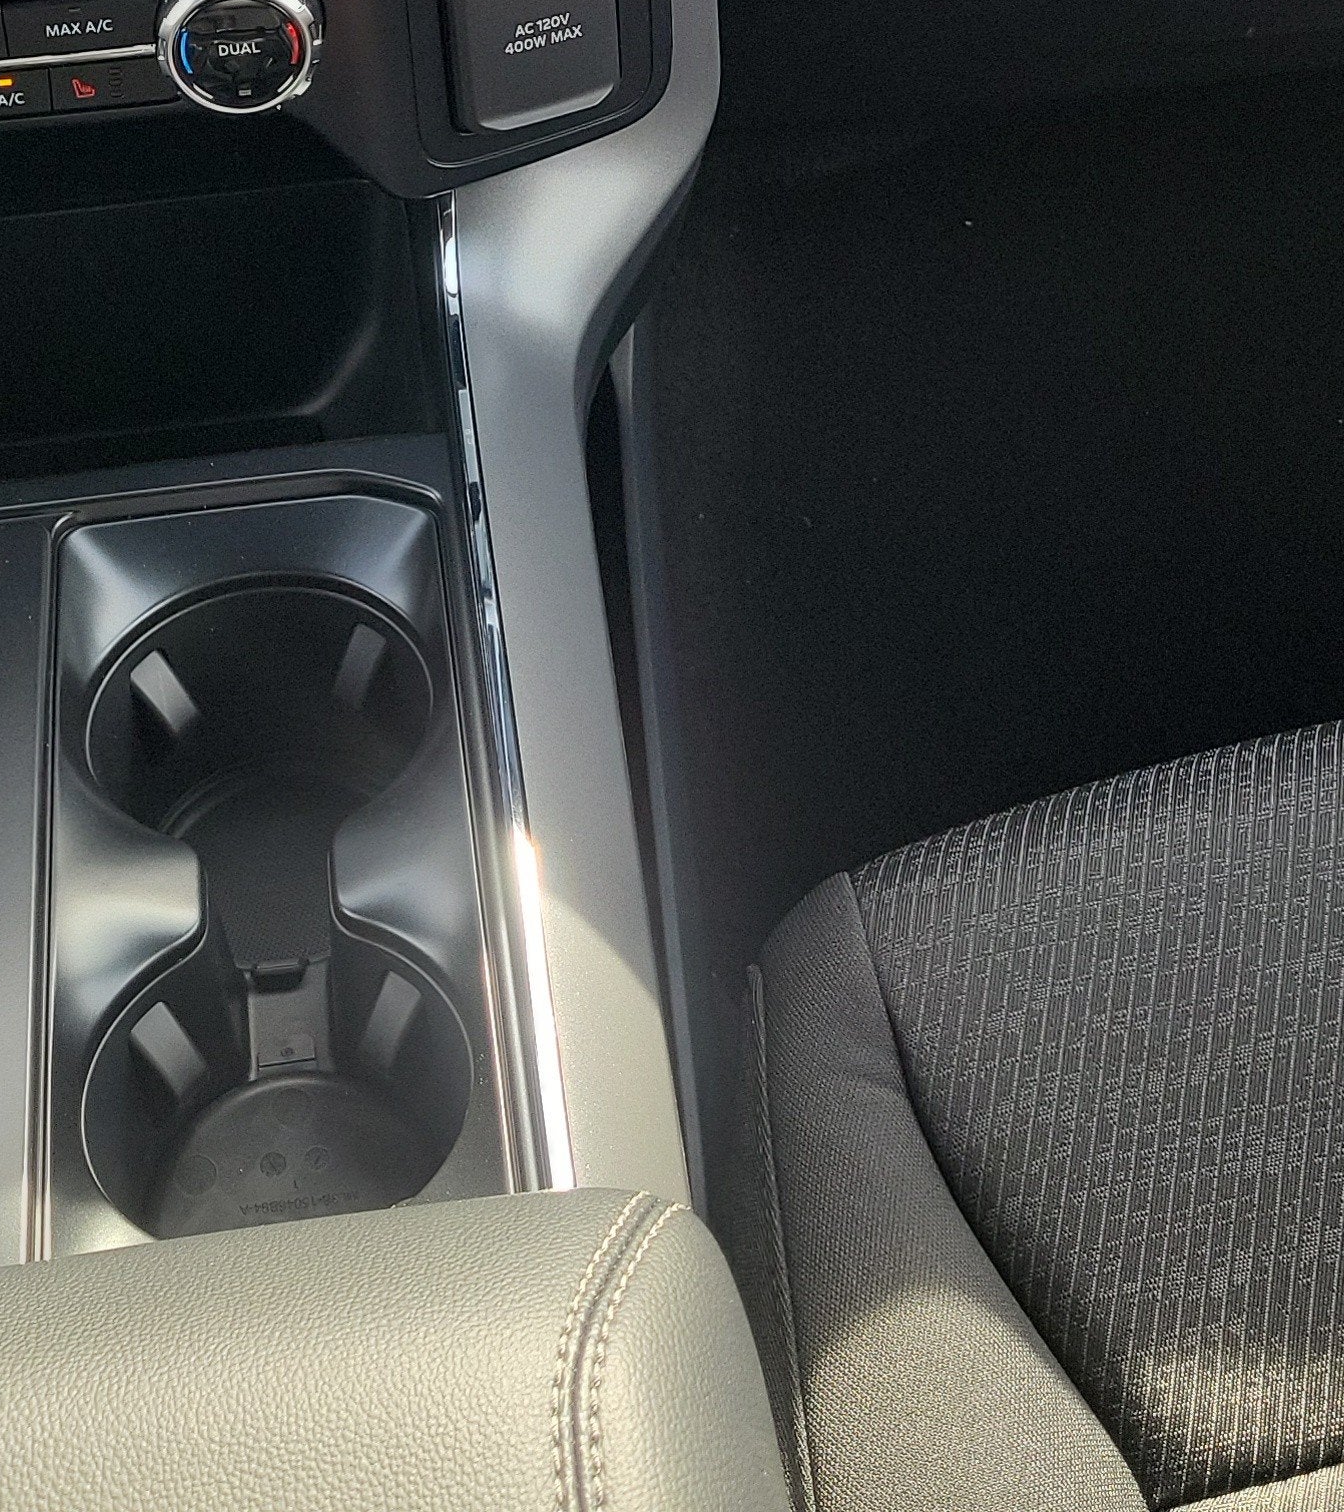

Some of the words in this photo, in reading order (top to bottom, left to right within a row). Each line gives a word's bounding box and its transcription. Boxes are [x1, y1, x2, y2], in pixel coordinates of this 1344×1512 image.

[46, 22, 81, 39] MAX
[85, 19, 114, 35] A/C
[515, 21, 535, 38] AC
[536, 13, 570, 34] 120V
[218, 41, 261, 57] DUAL
[505, 34, 548, 55] 400W
[551, 24, 583, 44] MAX
